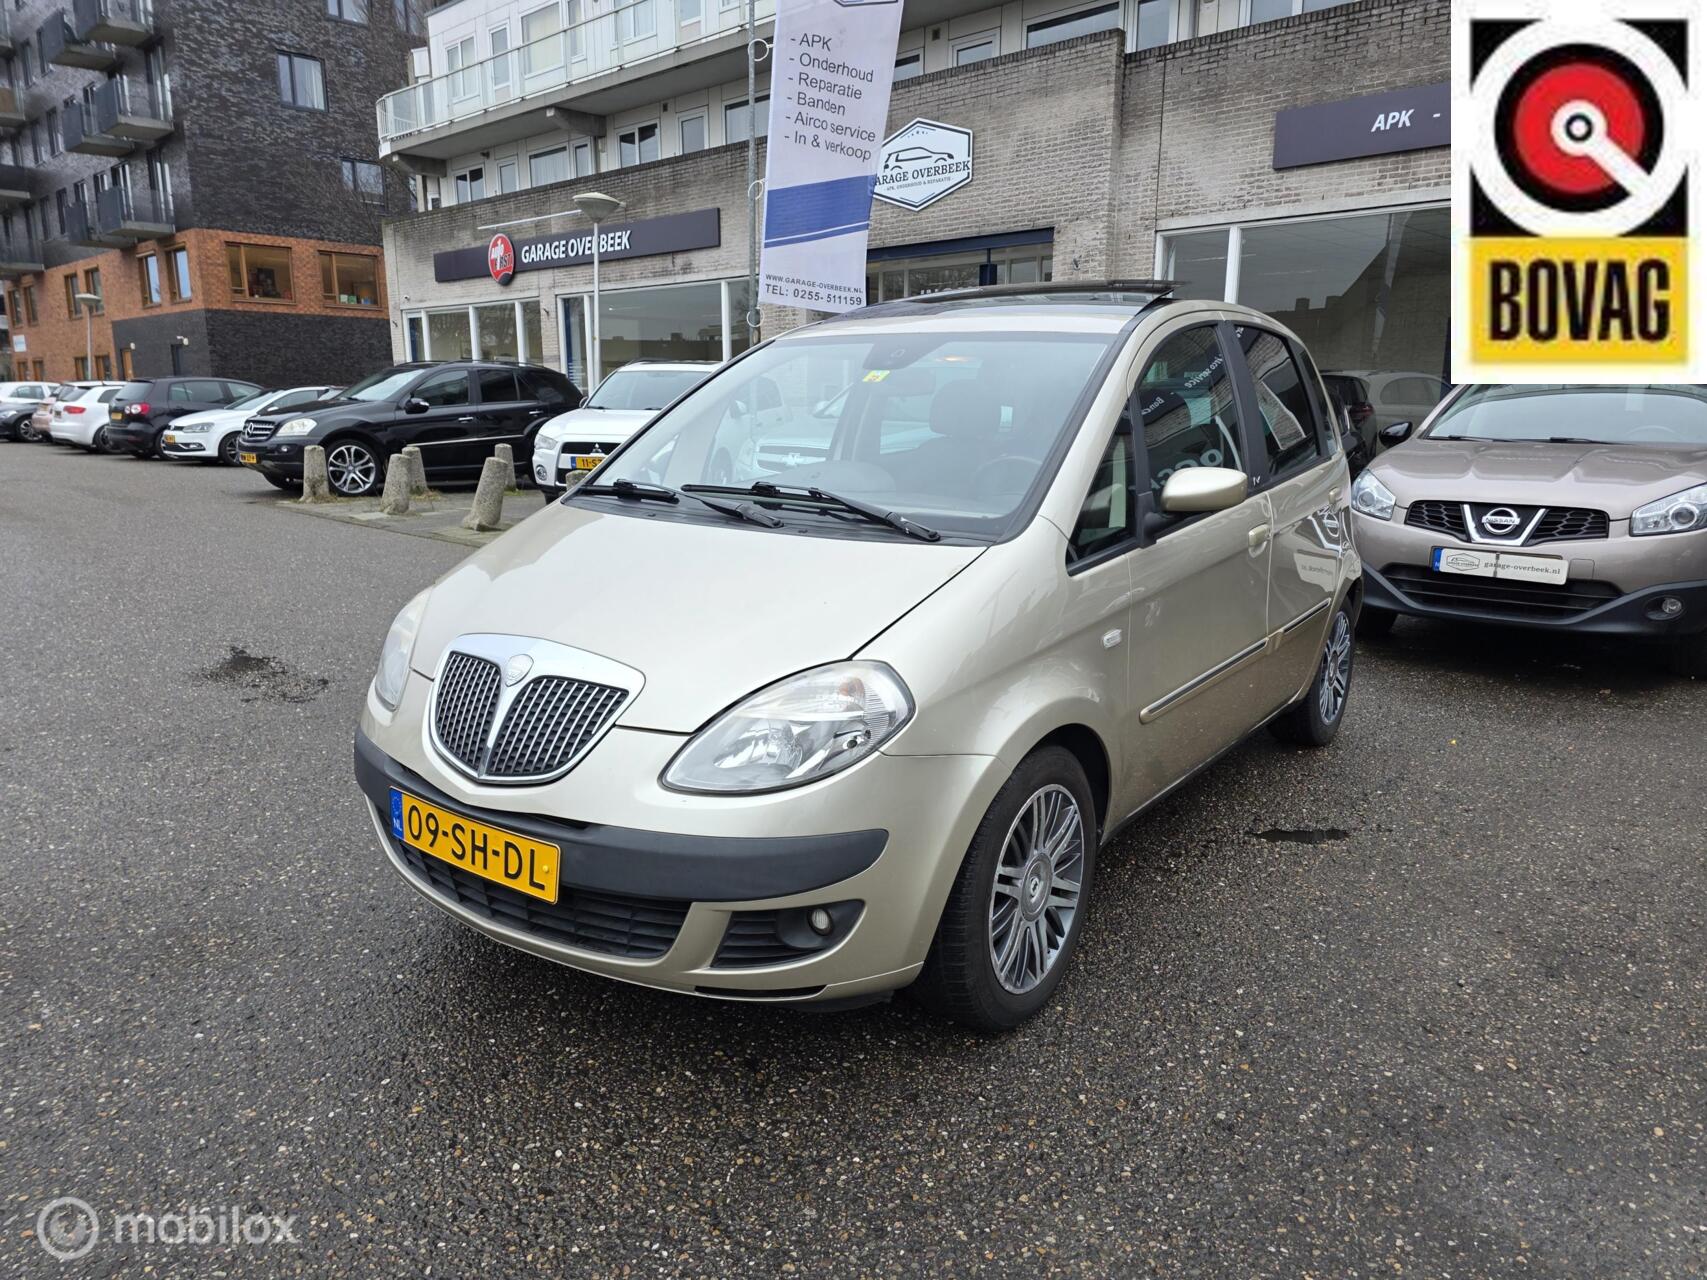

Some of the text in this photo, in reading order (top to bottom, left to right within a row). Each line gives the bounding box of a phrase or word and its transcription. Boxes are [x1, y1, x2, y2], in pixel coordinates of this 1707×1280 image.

[799, 32, 832, 52] APK
[799, 52, 874, 83] Onderhoud
[798, 71, 862, 100] Reparatie
[797, 91, 846, 116] Banden
[1371, 108, 1415, 132] APK
[794, 130, 807, 145] In
[824, 139, 871, 163] verkoop
[875, 160, 970, 186] ARAGE OVERBEEK
[521, 239, 566, 263] GARAGE
[765, 283, 789, 297] TEL:
[1484, 561, 1561, 575] garage-overbeek.nl
[407, 804, 546, 892] 09-SH-DL
